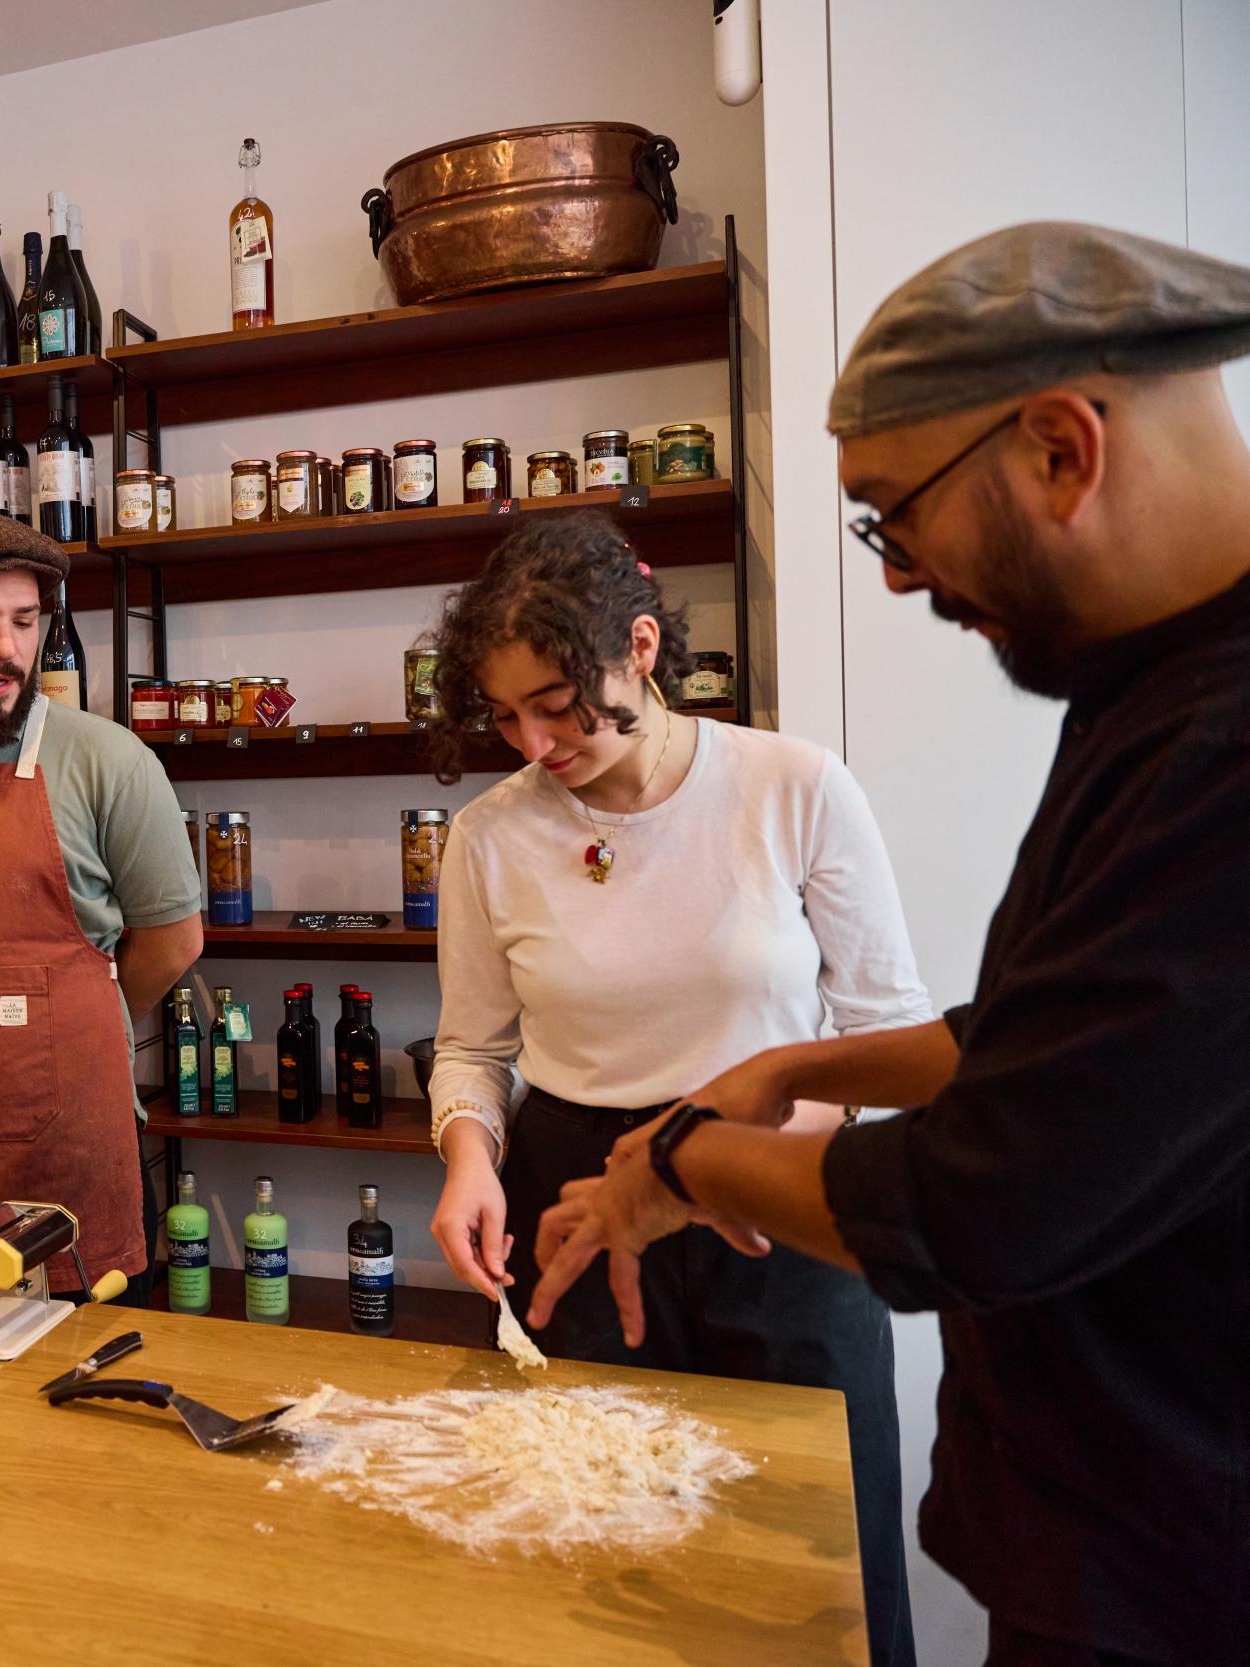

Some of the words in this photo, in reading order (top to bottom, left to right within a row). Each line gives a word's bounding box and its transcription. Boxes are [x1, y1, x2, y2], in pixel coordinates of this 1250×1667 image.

[19, 313, 37, 331] 18
[628, 496, 640, 507] 12
[179, 733, 186, 742] 6
[233, 737, 243, 746] 15
[233, 832, 248, 845] 24
[174, 1220, 186, 1231] 32
[253, 1229, 268, 1240] 32
